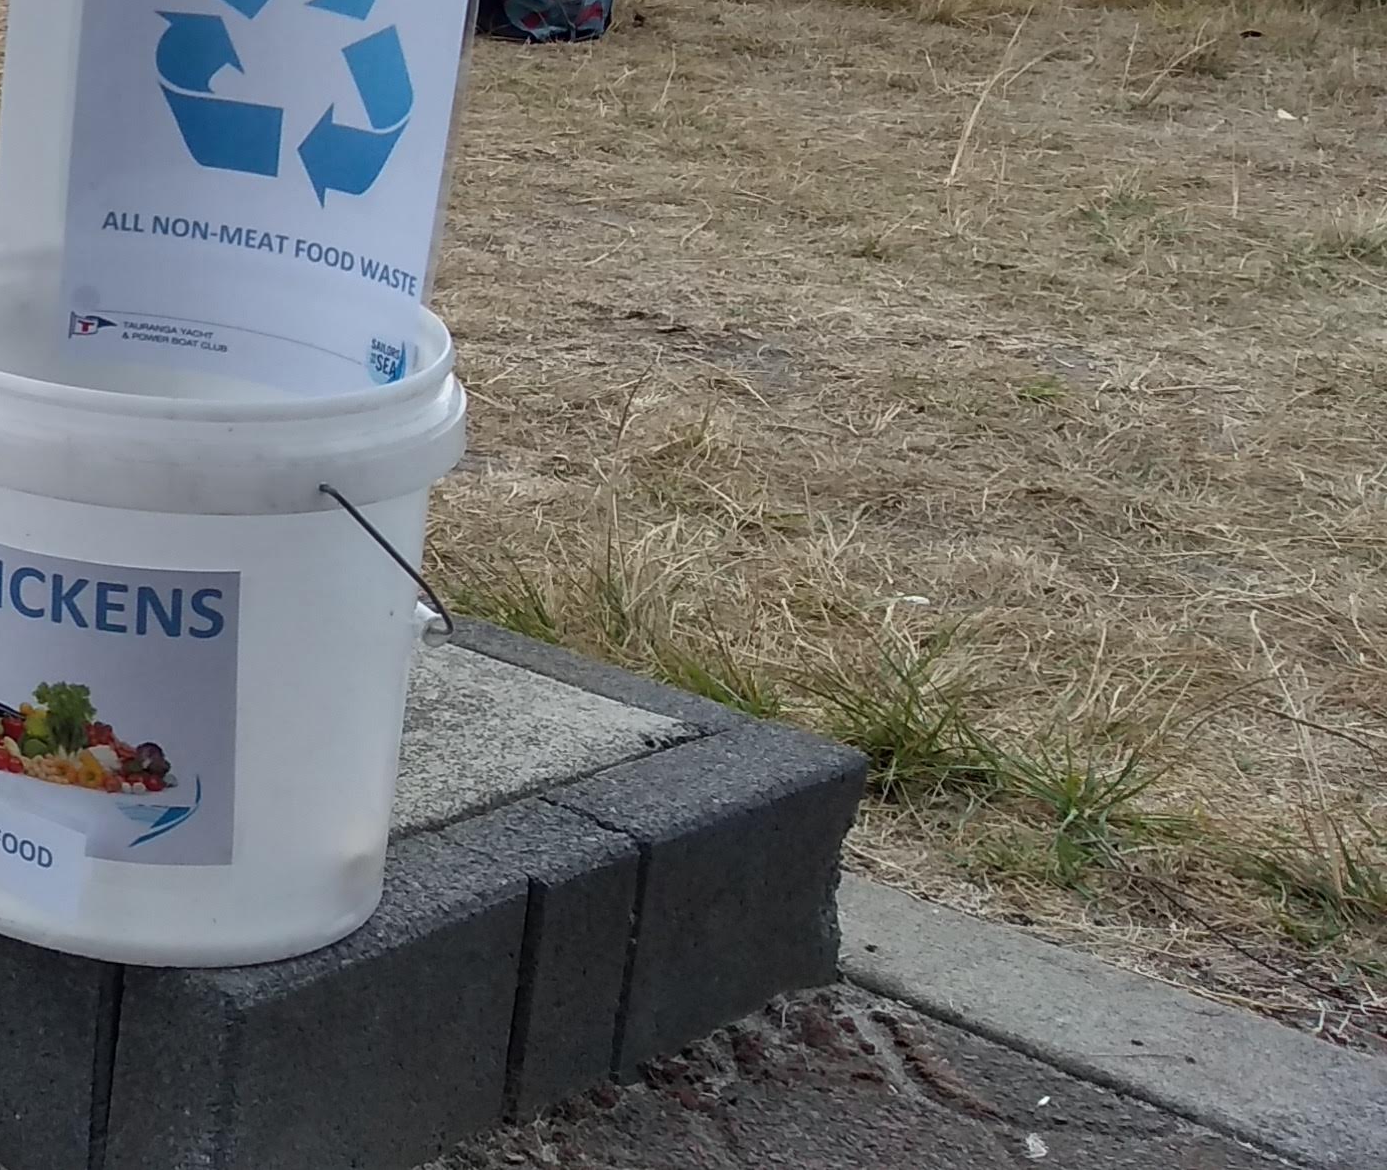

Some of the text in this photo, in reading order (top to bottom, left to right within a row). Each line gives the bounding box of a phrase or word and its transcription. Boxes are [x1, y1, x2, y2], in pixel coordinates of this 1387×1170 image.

[102, 211, 418, 297] ALL NON-MEAT FOOD WASTE
[123, 321, 214, 339] TAURANGA YACHT
[132, 332, 169, 343] POWER
[171, 337, 198, 347] BOAT
[200, 341, 228, 353] CLUB
[371, 338, 400, 360] SAILORS
[375, 354, 396, 379] SEA
